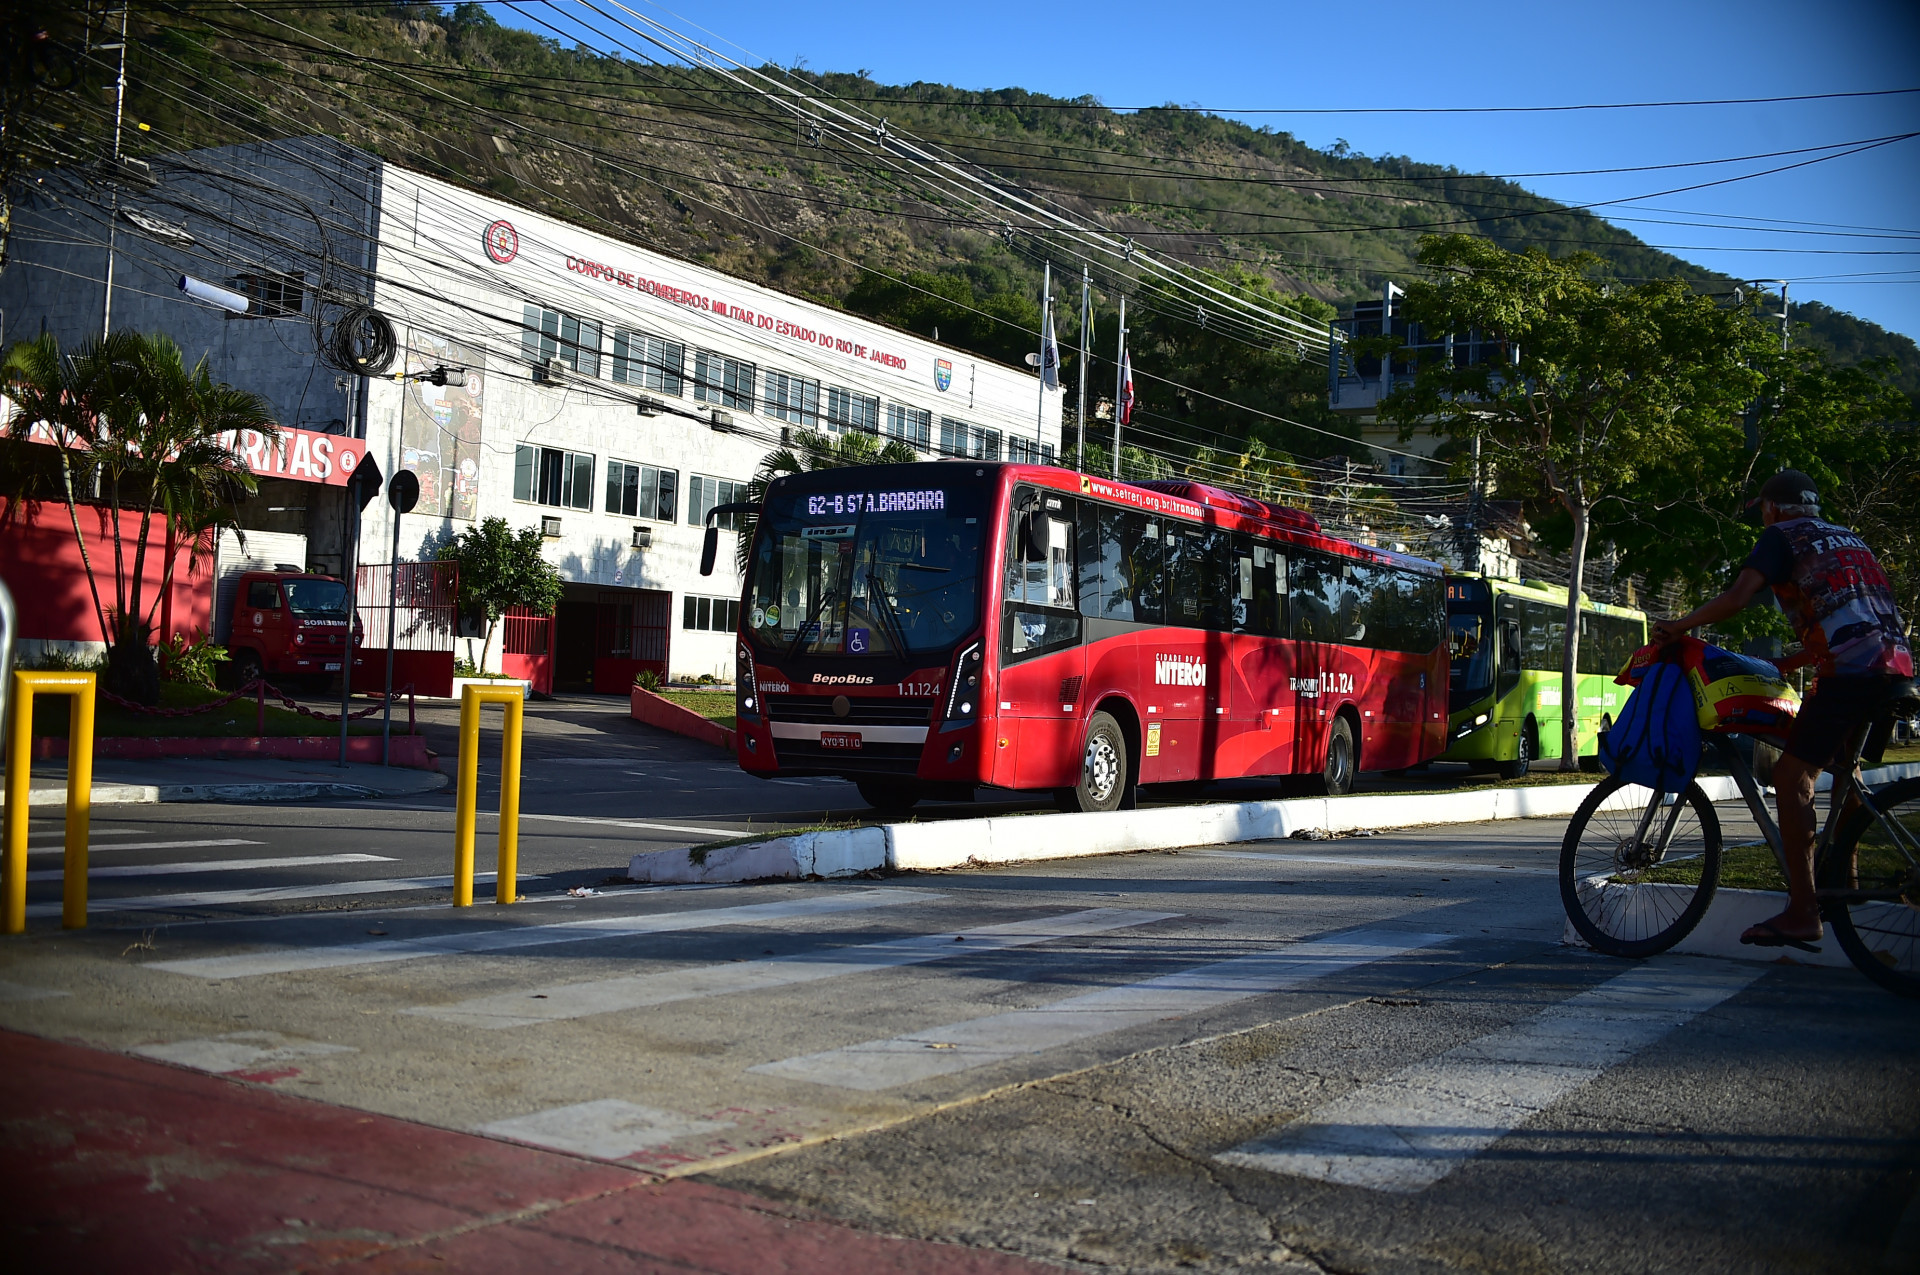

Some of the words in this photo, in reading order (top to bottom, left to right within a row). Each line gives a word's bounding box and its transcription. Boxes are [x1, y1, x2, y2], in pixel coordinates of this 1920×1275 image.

[566, 255, 615, 282] CORPO
[617, 270, 635, 289] DE
[638, 276, 710, 311] BOMBEIROS
[711, 299, 755, 325] MILITAR
[757, 313, 774, 330] DO
[775, 319, 817, 344] ESTADO
[818, 332, 834, 349] DO
[835, 338, 853, 355] RIO
[854, 343, 868, 358] DE
[869, 348, 907, 371] JANEIRO
[808, 494, 844, 515] 62-B
[1155, 653, 1182, 663] CIDADE
[1185, 655, 1194, 664] DE
[812, 673, 874, 685] BepoBus
[1155, 656, 1207, 687] NITERÓI
[759, 681, 790, 693] NITERÓI
[898, 682, 941, 696] 1.1.124
[1321, 671, 1354, 694] 1.1.124
